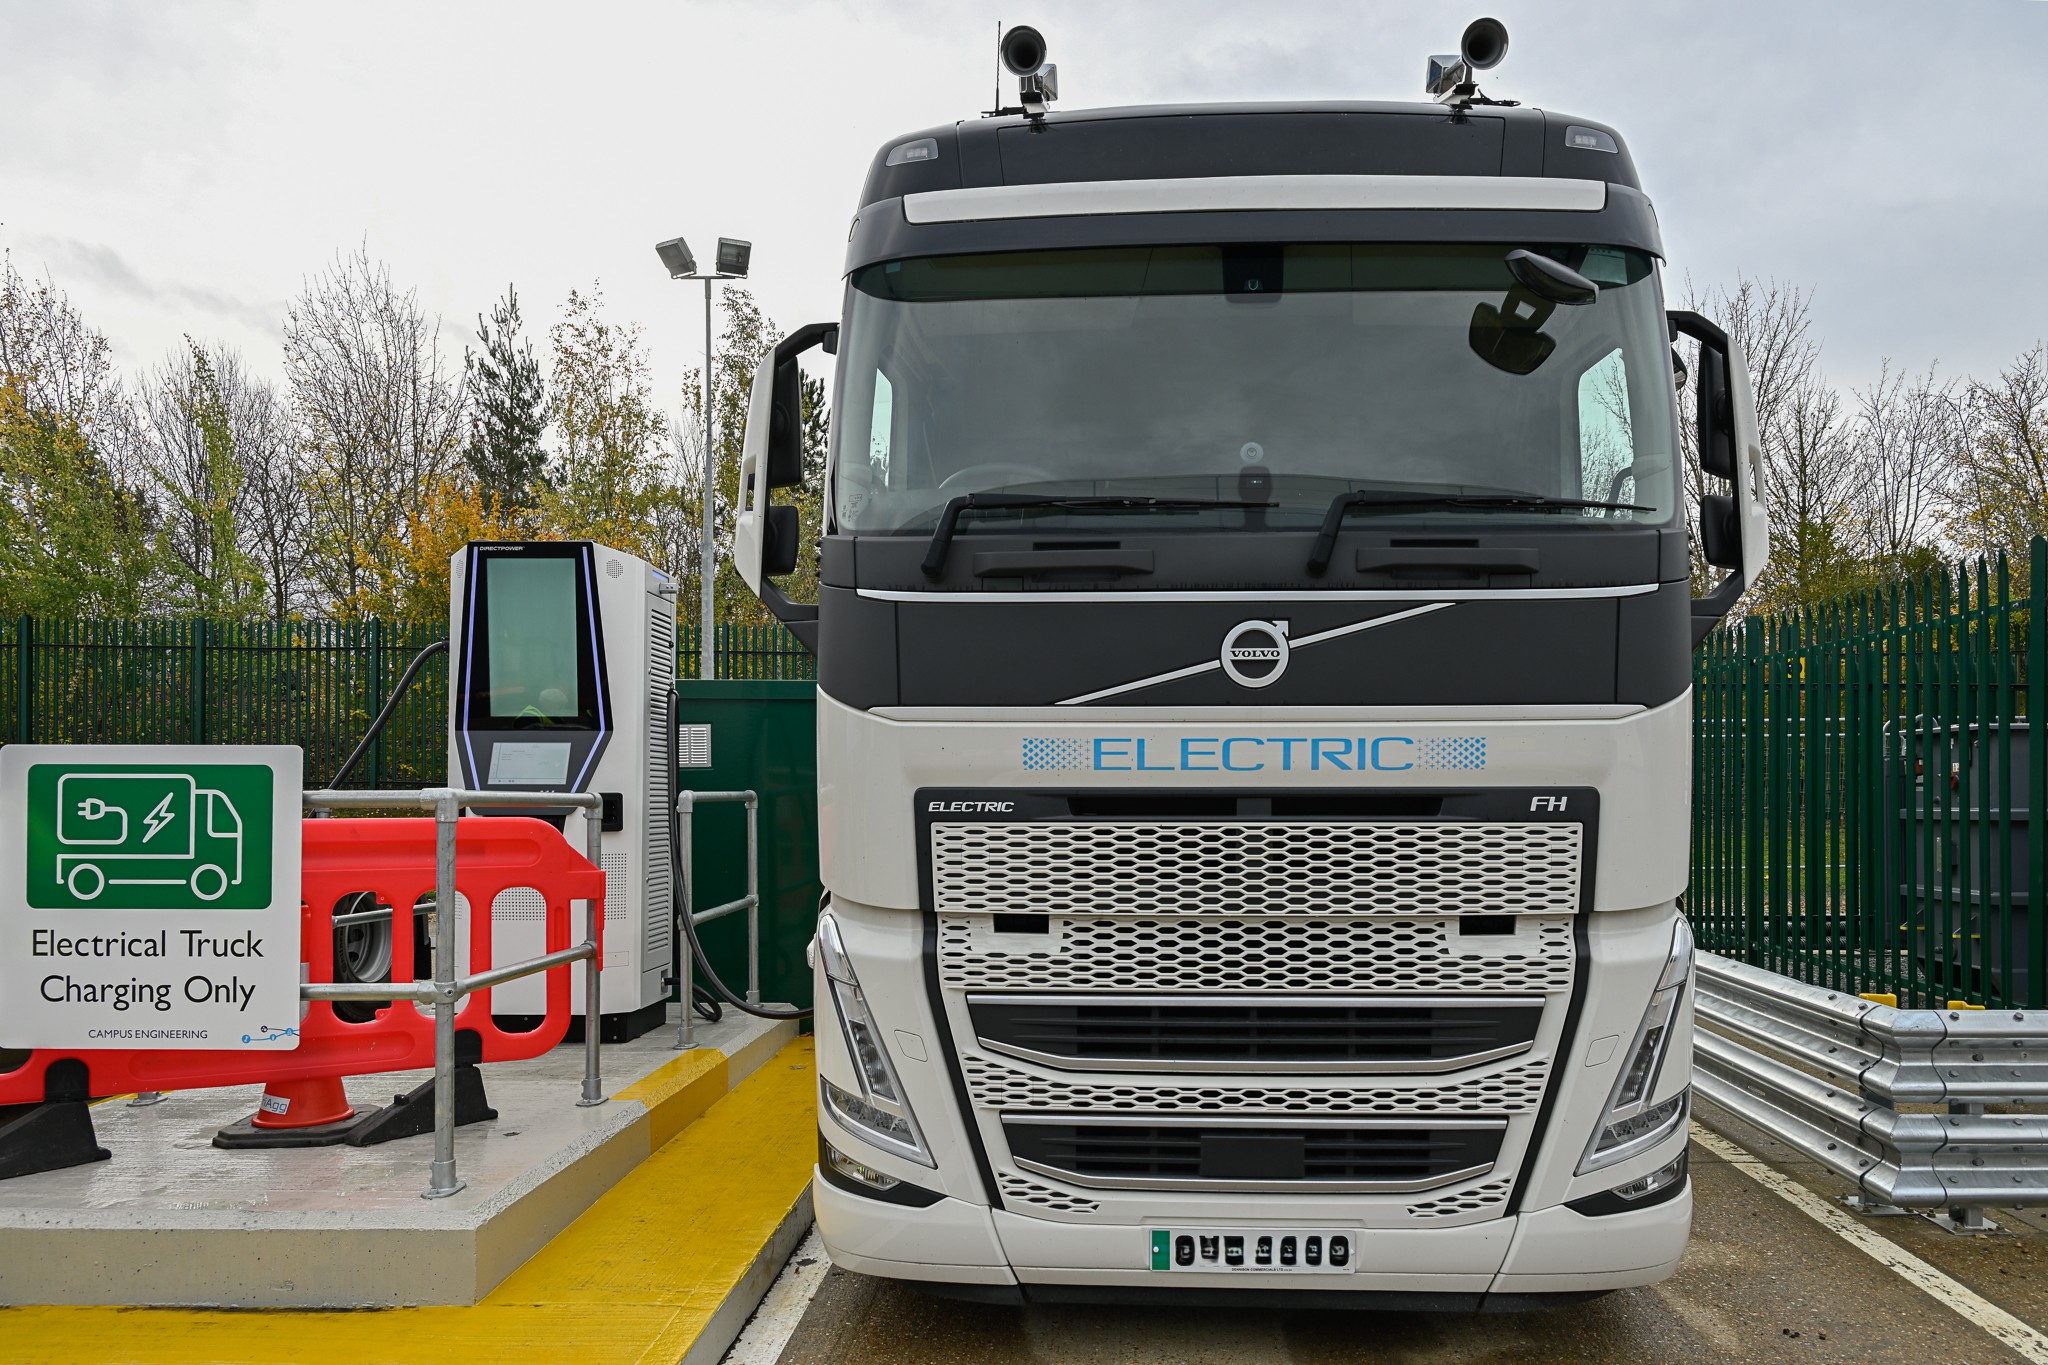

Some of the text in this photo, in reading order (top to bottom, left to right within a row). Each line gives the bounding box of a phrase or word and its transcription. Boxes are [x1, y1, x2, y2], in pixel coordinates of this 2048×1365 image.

[1229, 649, 1281, 658] VOLVO
[1093, 737, 1414, 771] ELECTRIC
[927, 801, 1015, 813] ELECTRIC
[1529, 796, 1568, 812] FH
[32, 929, 264, 957] Electrical Truck
[40, 974, 256, 1012] Charging Only
[88, 1029, 208, 1039] CAMPUS ENGINEERING
